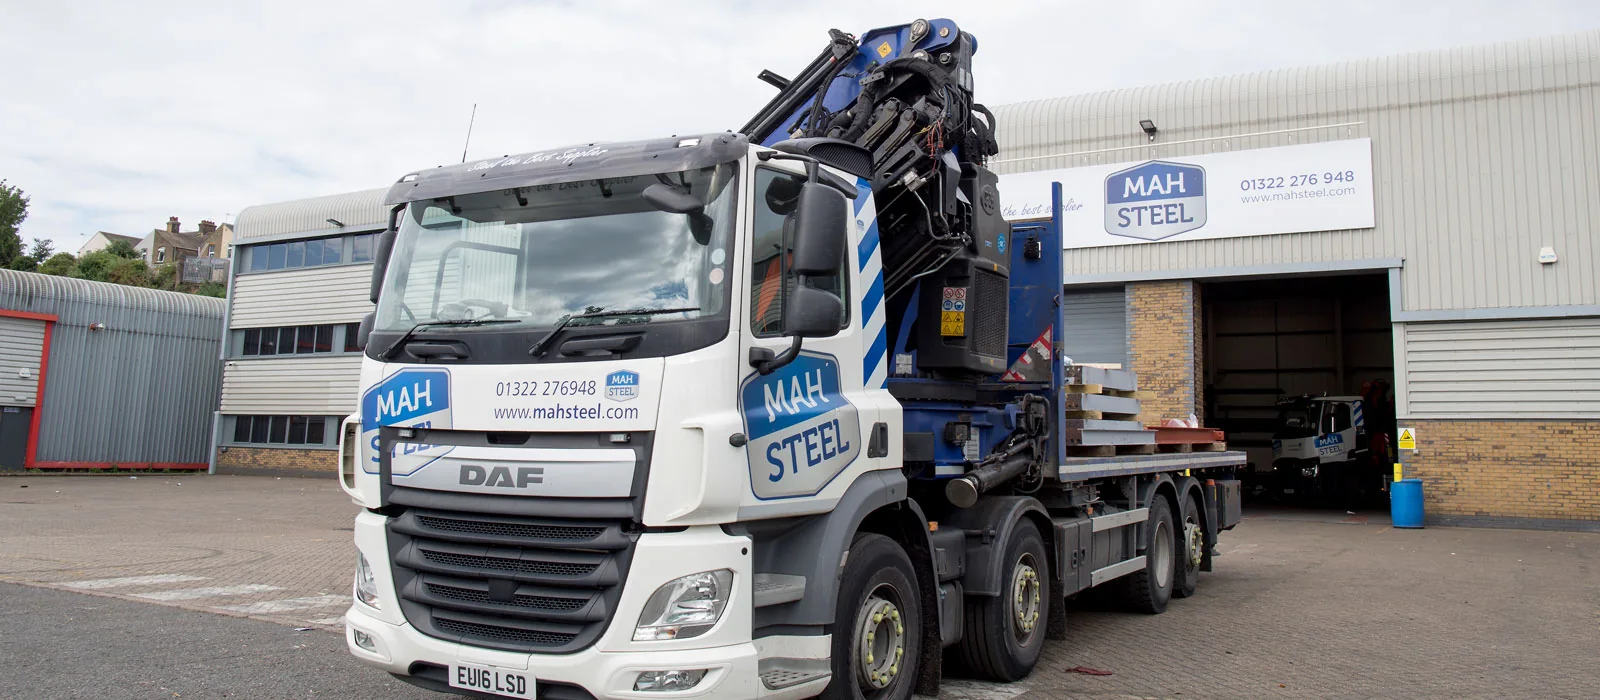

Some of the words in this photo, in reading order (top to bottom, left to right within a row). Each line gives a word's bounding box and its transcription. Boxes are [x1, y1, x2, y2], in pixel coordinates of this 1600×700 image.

[1122, 171, 1186, 198] MAH
[1240, 176, 1284, 191] 01322
[1289, 173, 1318, 187] 276
[1323, 170, 1354, 184] 948
[1240, 187, 1356, 203] www.mahsteel.com
[1002, 205, 1017, 217] the
[1021, 203, 1042, 216] best
[1045, 198, 1083, 214] slier
[1117, 203, 1194, 228] STEEL
[495, 381, 538, 397] 01322
[542, 380, 597, 396] 276948
[611, 374, 633, 385] MAH
[375, 379, 432, 422] MAH
[608, 387, 634, 397] STEEL
[764, 368, 829, 423] MAH
[494, 403, 639, 420] www.mahsteel.com
[766, 418, 850, 483] STEEL
[1318, 436, 1339, 447] MAH
[1319, 446, 1342, 456] STEEL
[459, 465, 544, 488] DAF
[457, 665, 491, 689] EU16
[495, 671, 526, 695] LSD
